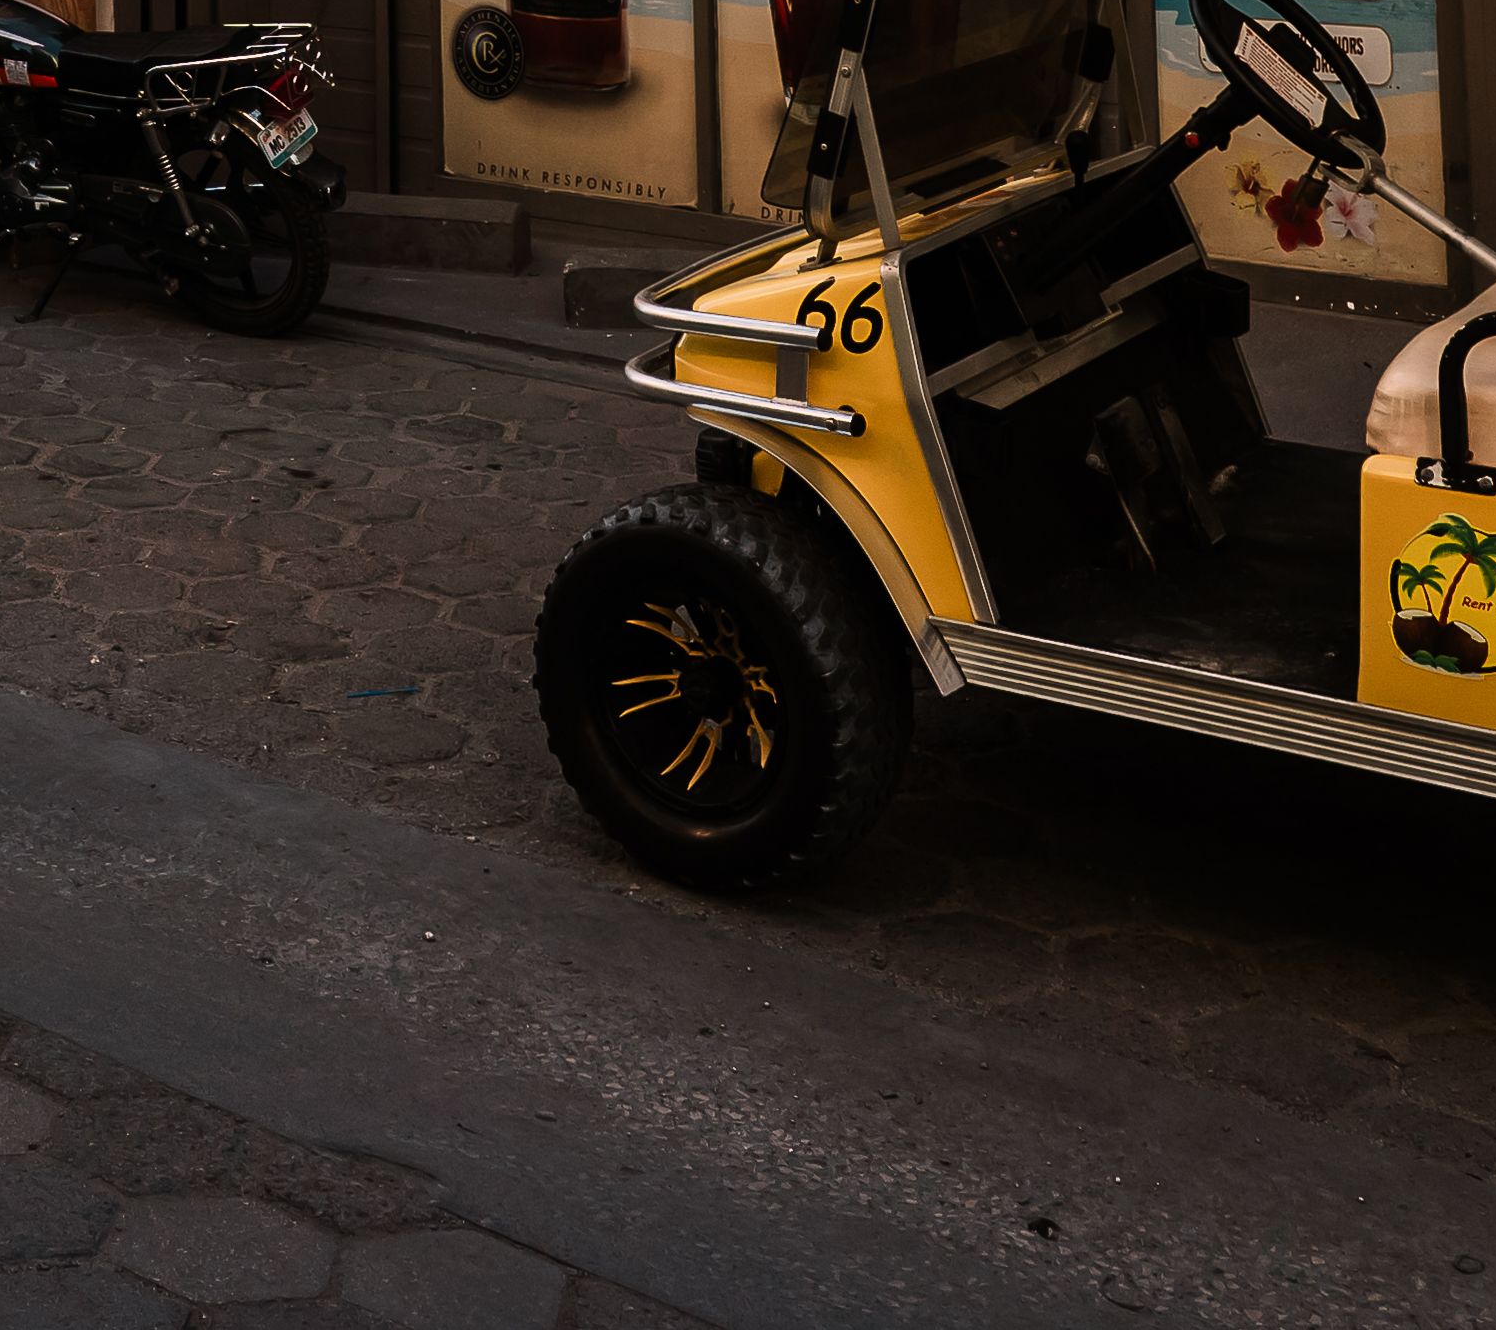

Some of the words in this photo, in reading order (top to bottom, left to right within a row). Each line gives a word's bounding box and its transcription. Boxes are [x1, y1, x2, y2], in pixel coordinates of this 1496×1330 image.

[269, 135, 285, 155] MC
[478, 162, 530, 181] DRINK
[542, 171, 668, 201] RESPONSIBLY
[1462, 596, 1494, 613] Rent
